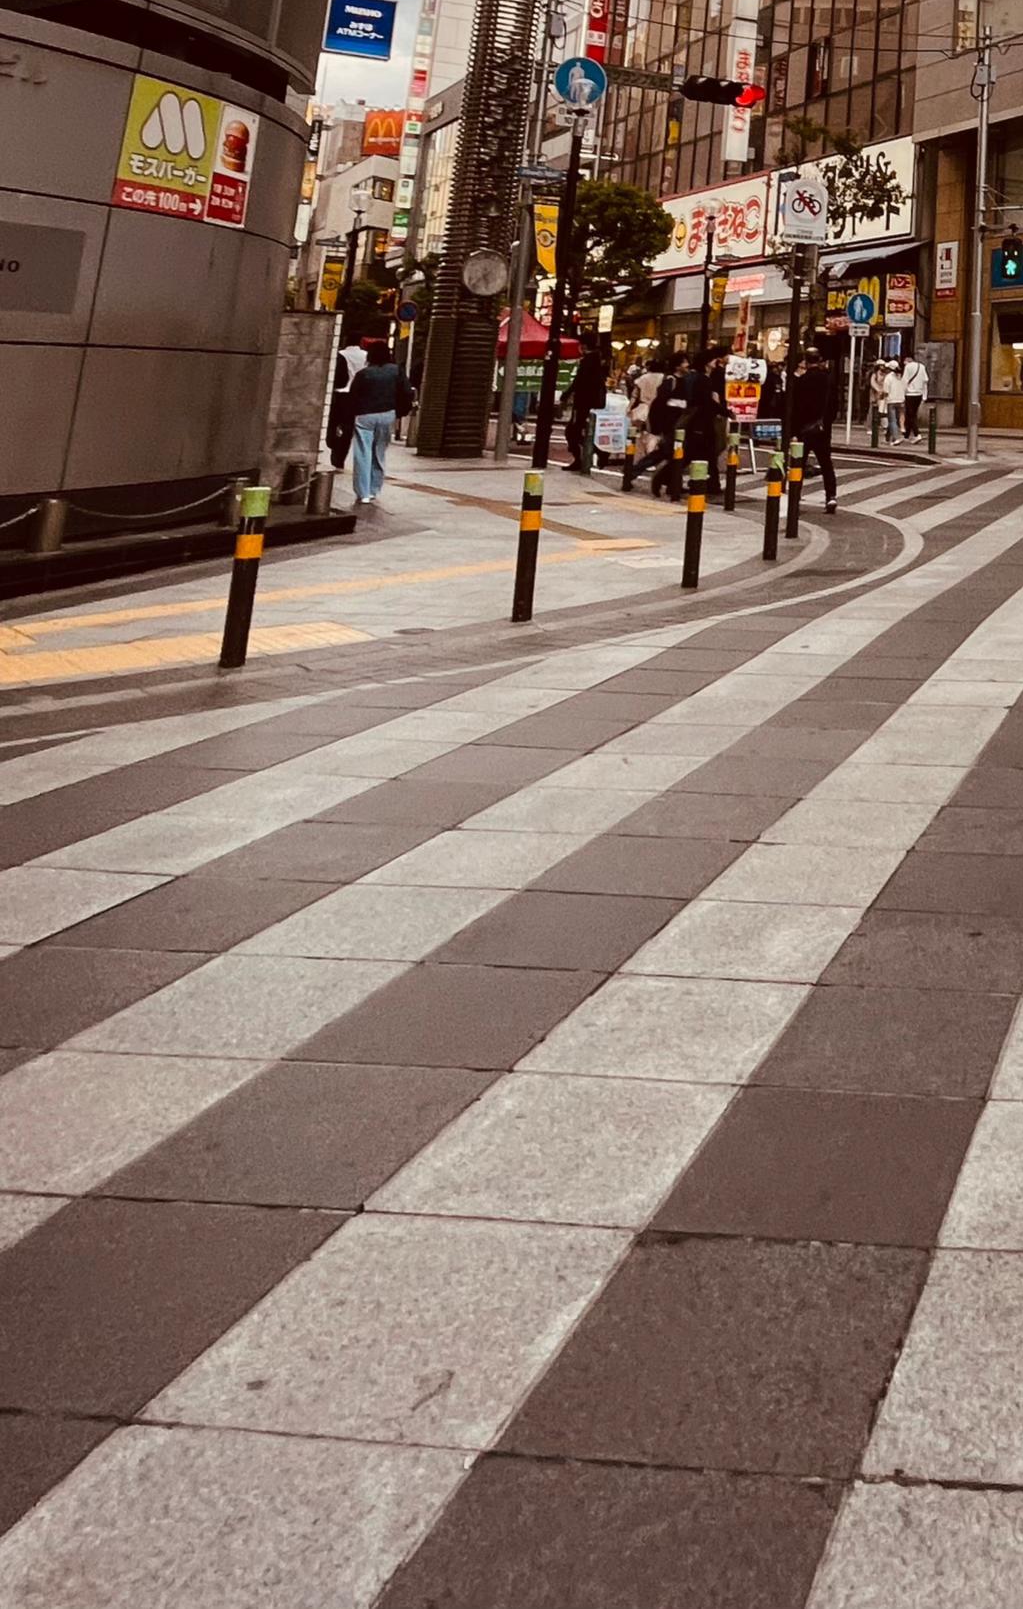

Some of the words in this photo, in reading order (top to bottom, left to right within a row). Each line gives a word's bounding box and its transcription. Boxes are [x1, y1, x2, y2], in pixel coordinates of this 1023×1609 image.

[129, 153, 208, 186] モスバーガー
[687, 197, 762, 257] まきねこ
